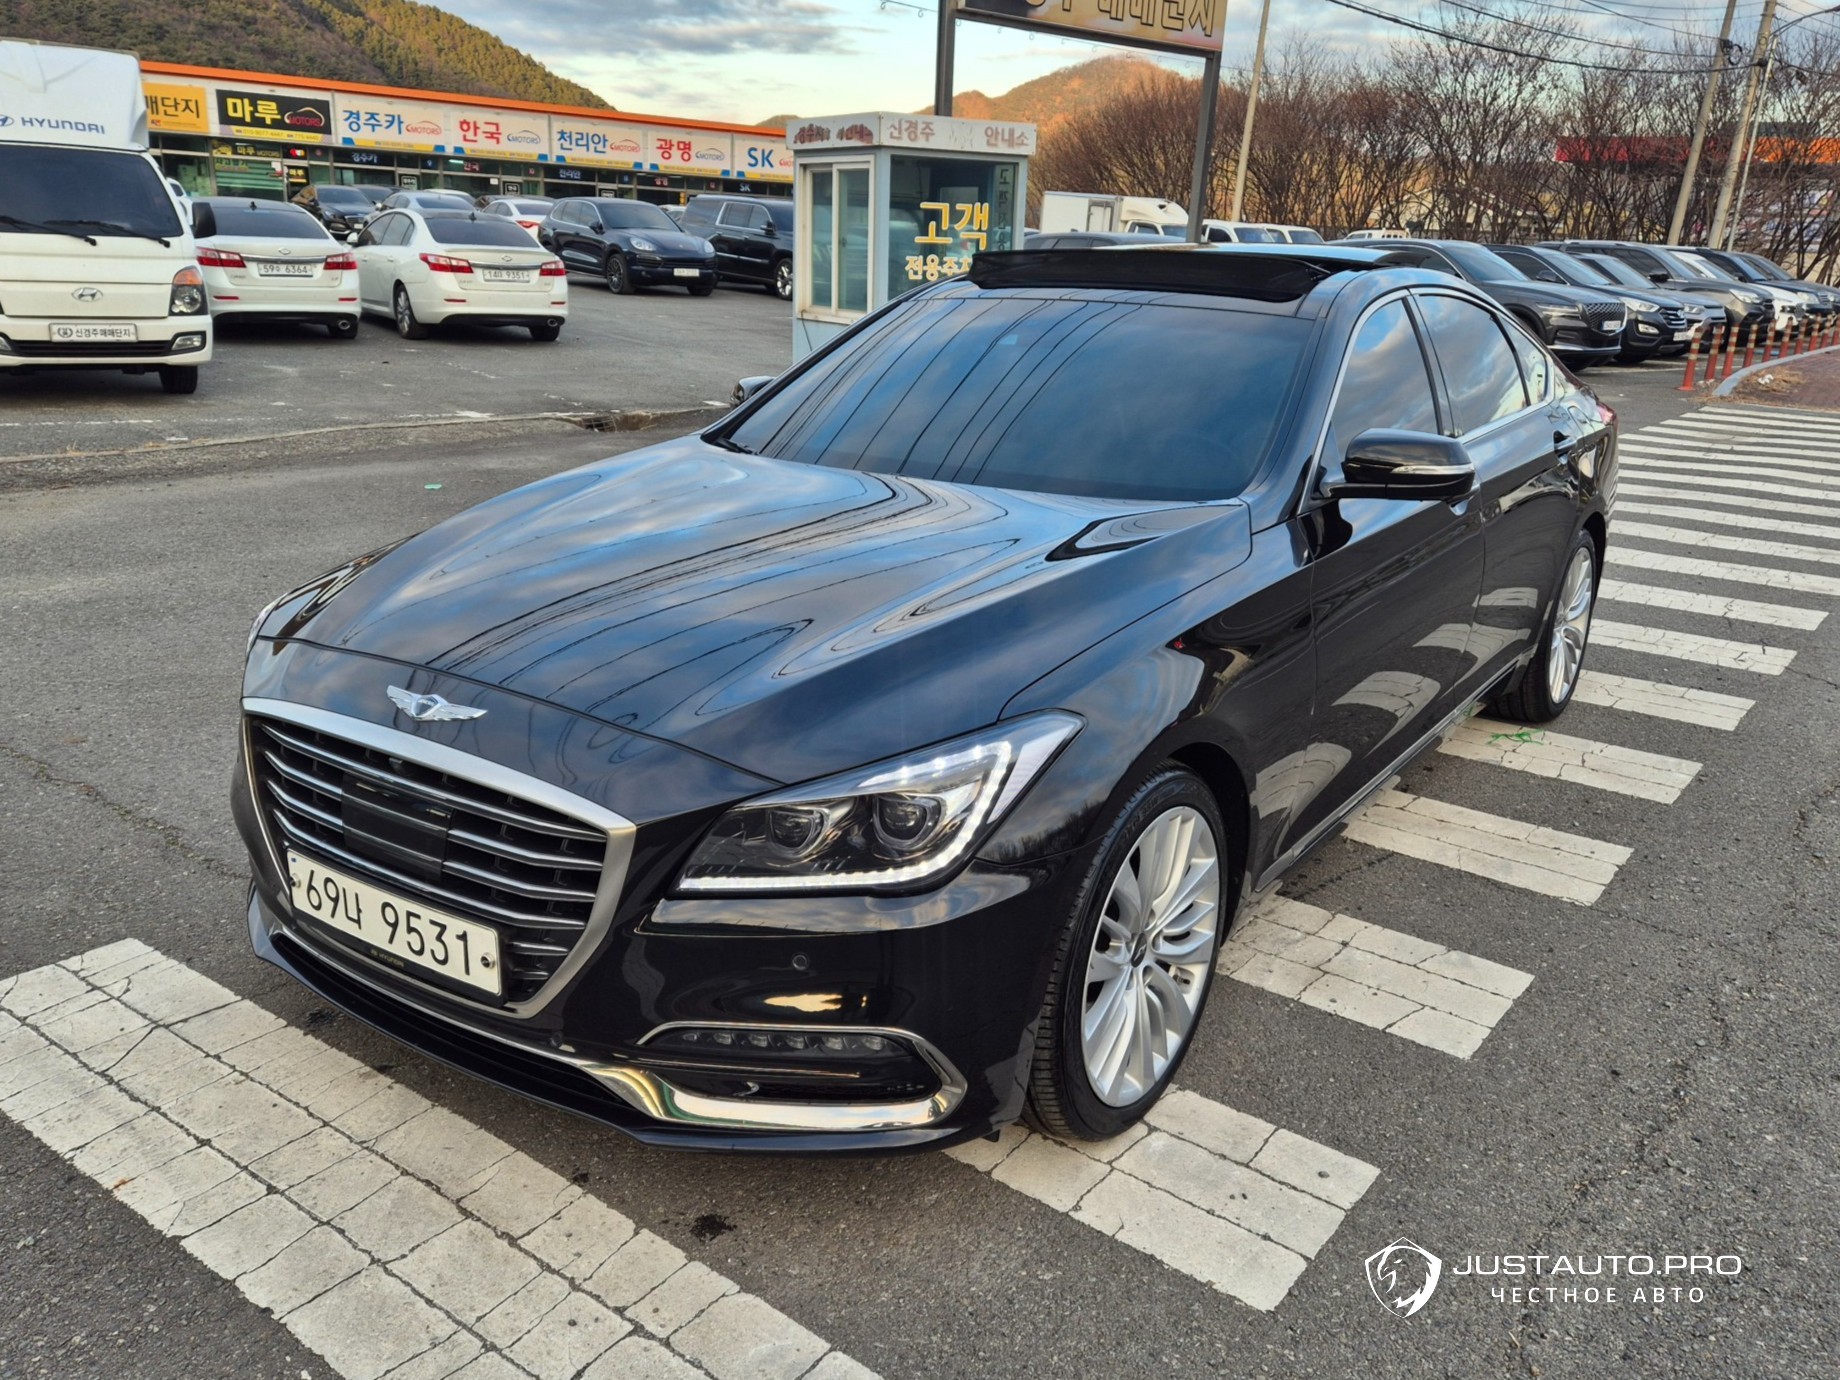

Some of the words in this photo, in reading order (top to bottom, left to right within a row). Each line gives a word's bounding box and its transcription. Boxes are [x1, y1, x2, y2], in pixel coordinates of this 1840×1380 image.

[226, 97, 281, 125] 마루
[288, 115, 321, 127] MOTORS
[343, 110, 404, 135] 경주카
[21, 117, 105, 134] HYUNDAI
[411, 126, 439, 135] MOTORS
[459, 119, 502, 144] 한국
[888, 118, 936, 142] 신경주
[984, 125, 1030, 148] 안내소
[511, 136, 540, 144] MOTORS
[557, 129, 608, 154] 천리안
[614, 145, 640, 153] MOTORS
[656, 138, 691, 162] 광명
[700, 153, 723, 161] MOTORS
[748, 147, 774, 168] SK
[914, 201, 989, 251] 고객
[307, 869, 363, 930] 69나
[381, 901, 470, 976] 9531
